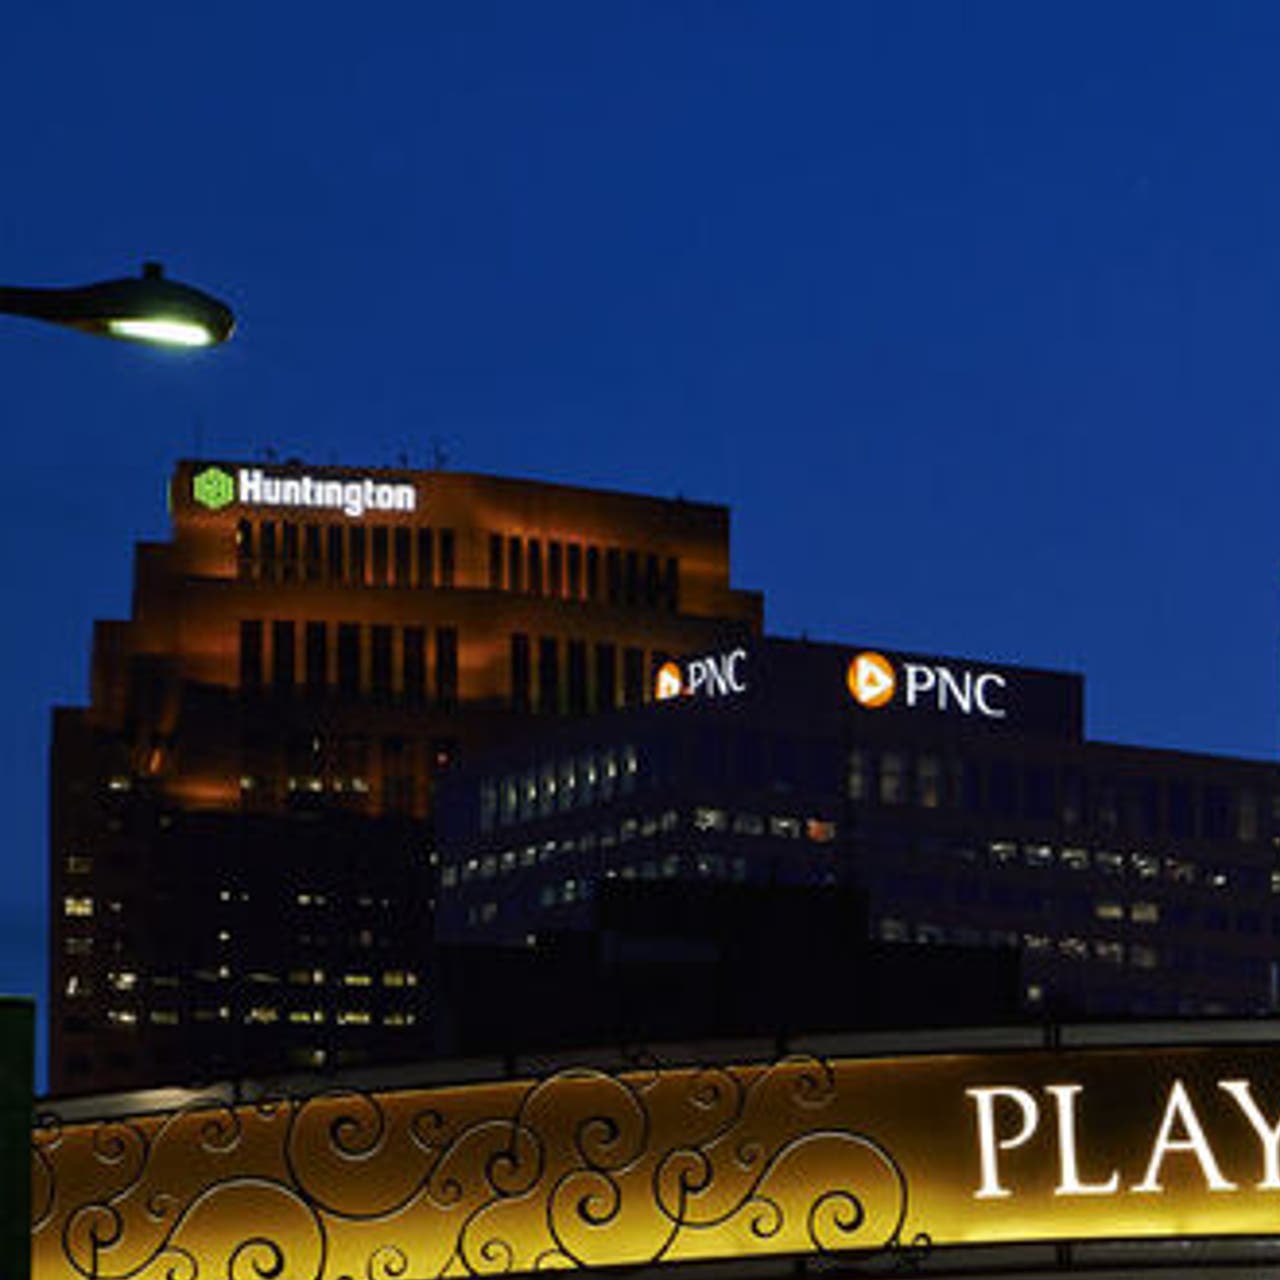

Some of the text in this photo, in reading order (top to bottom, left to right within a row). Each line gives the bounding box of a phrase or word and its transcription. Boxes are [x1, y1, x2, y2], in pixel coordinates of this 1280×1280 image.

[239, 469, 416, 516] Huntington
[687, 649, 747, 698] PNC
[904, 663, 1006, 717] PNC
